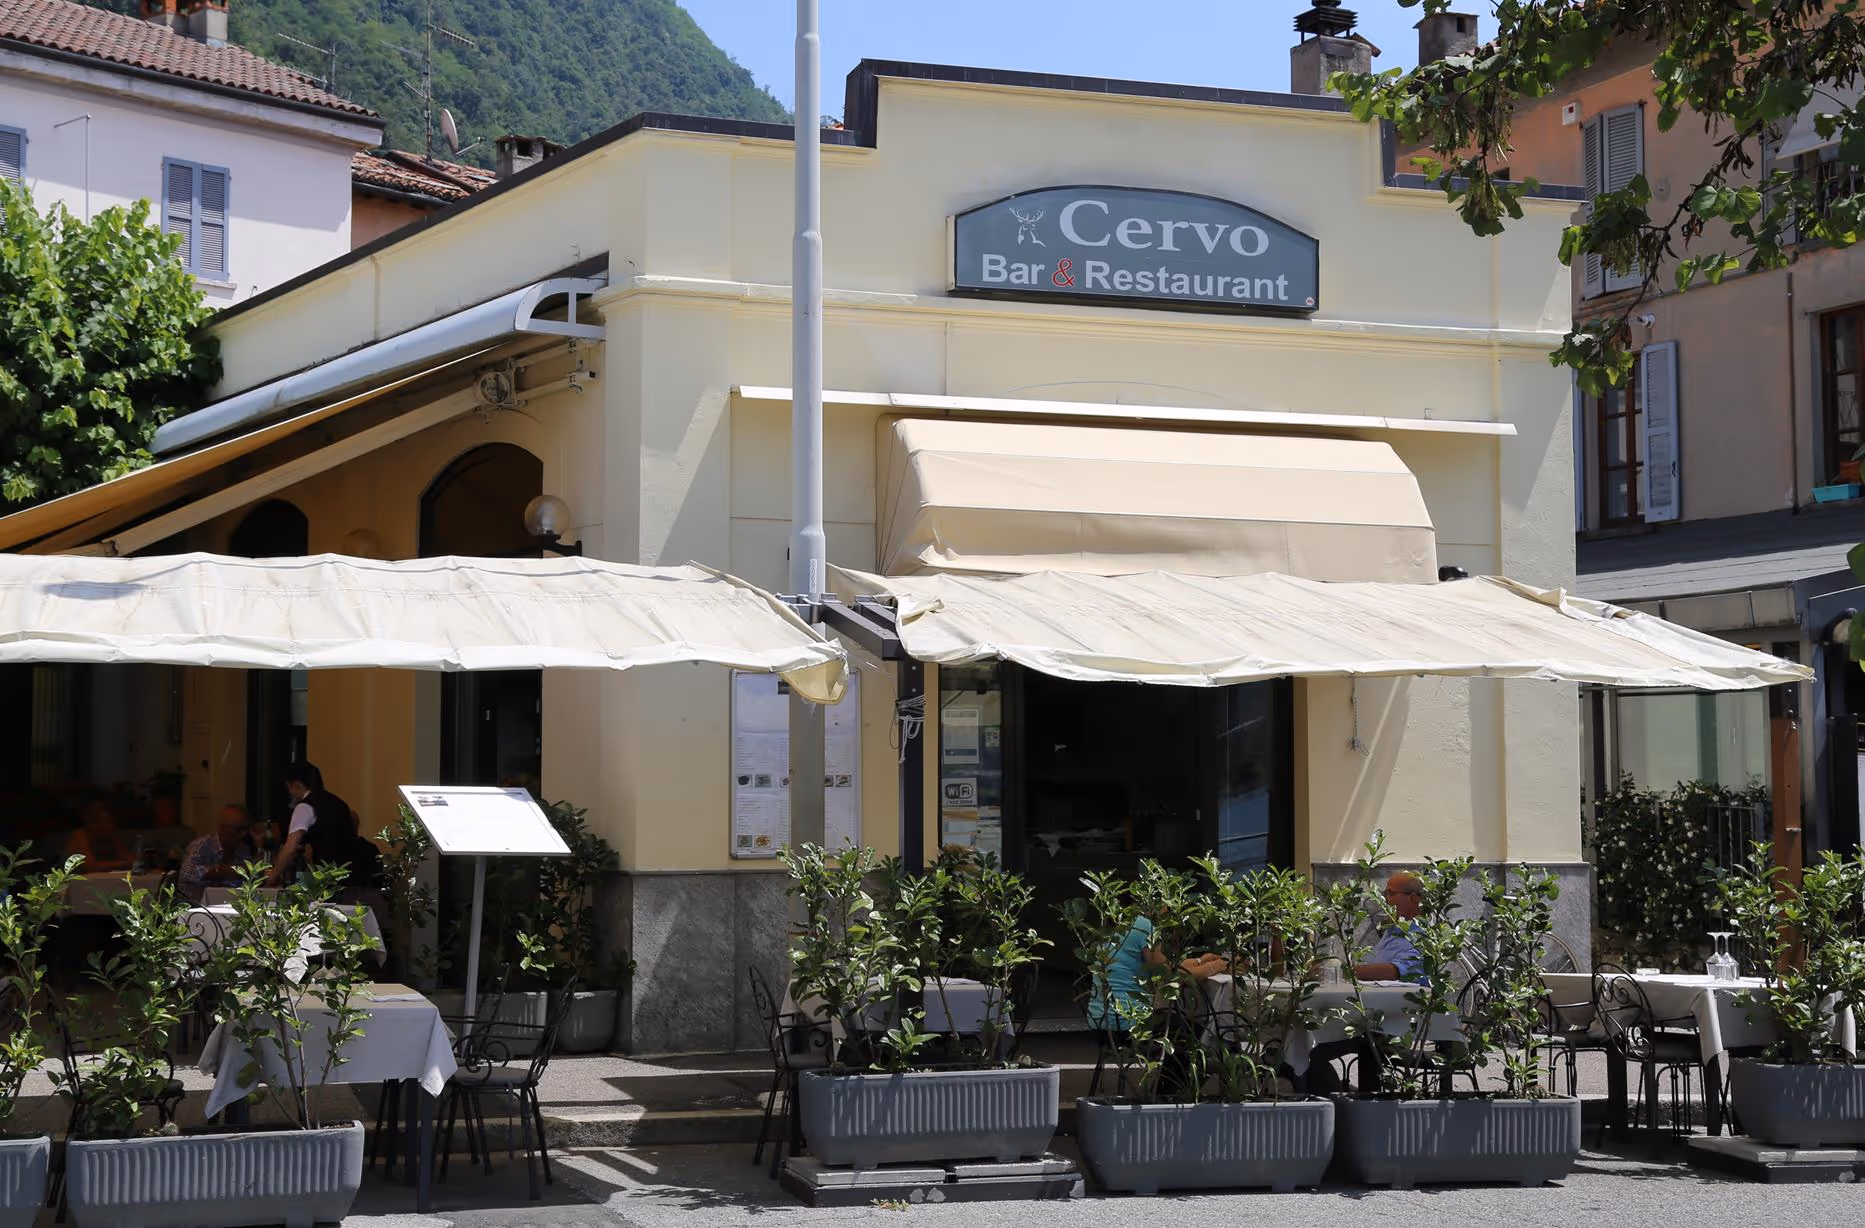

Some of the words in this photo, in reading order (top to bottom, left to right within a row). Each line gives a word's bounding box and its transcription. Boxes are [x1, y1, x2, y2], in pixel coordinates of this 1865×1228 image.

[1060, 200, 1269, 257] Cervo
[982, 254, 1045, 285] Bar
[1052, 257, 1076, 287] &
[1086, 261, 1289, 301] Restaurant
